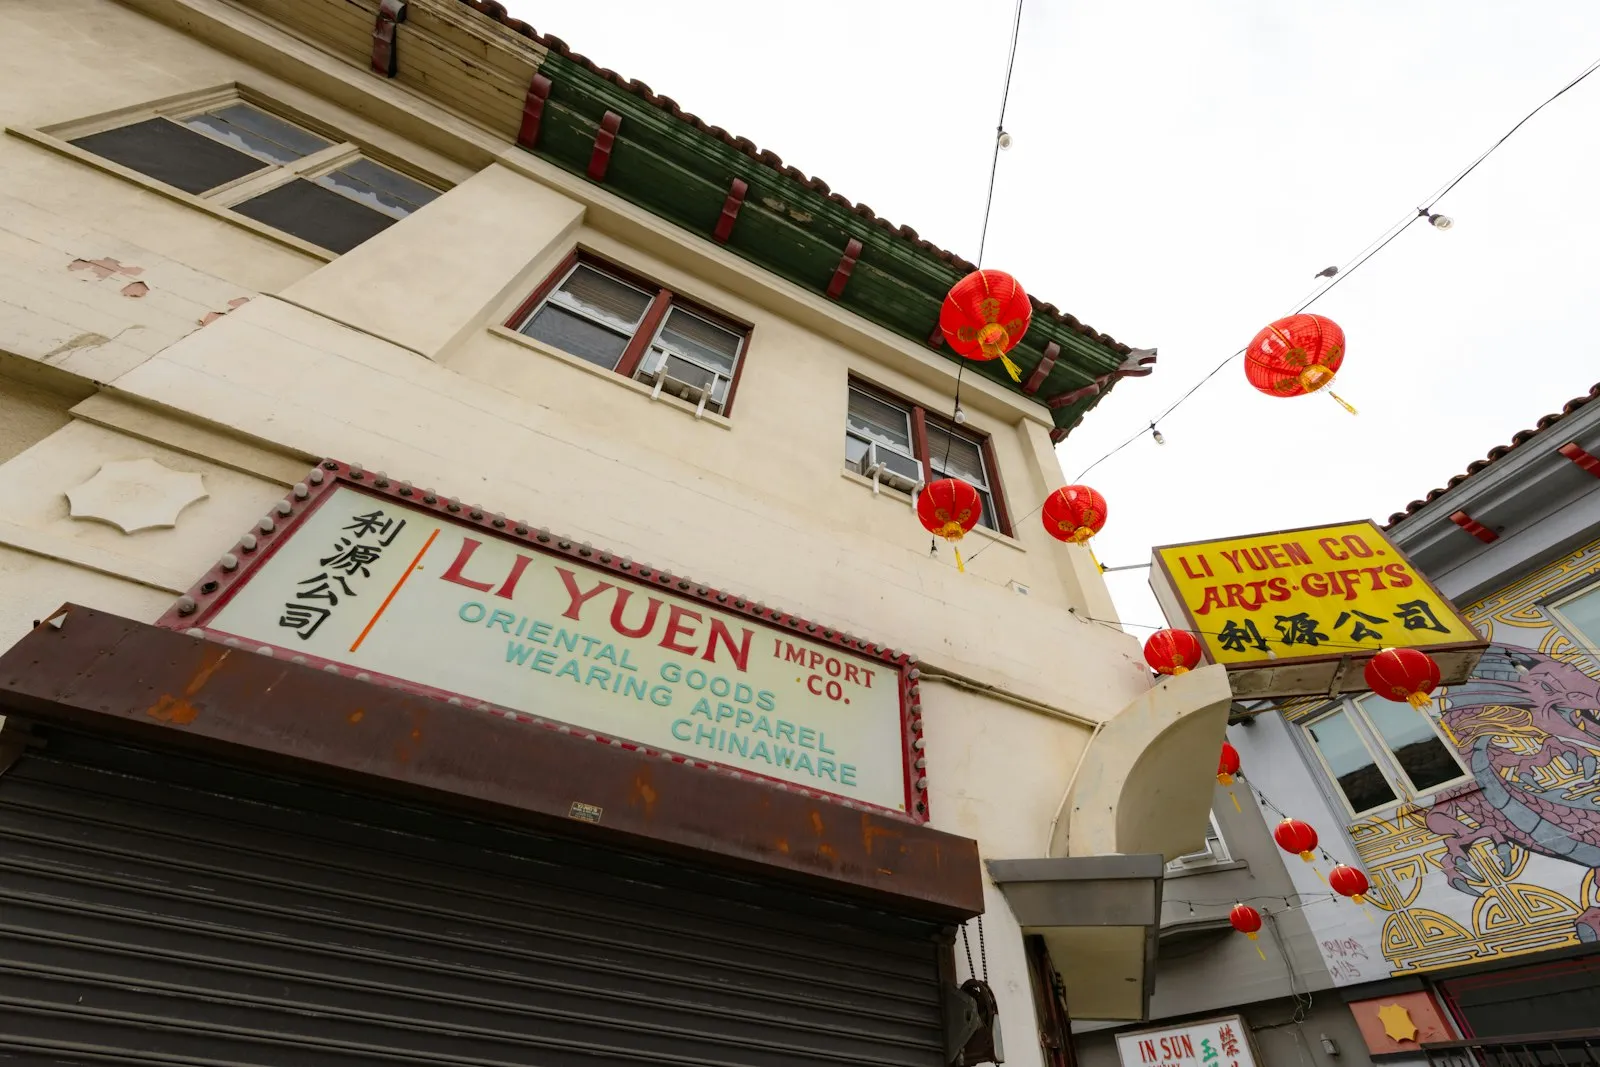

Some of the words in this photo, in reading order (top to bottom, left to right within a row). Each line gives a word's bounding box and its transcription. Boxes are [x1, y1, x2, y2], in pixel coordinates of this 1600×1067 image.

[278, 510, 407, 641] 利源公司
[1178, 555, 1214, 579] LI
[1220, 542, 1313, 573] YUEN
[1318, 534, 1386, 562] CO.
[440, 537, 533, 600] LI
[554, 565, 755, 673] YUEN
[1217, 599, 1451, 653] 利源公司
[458, 601, 639, 672] ORIENTAL
[660, 662, 777, 712] GOODS
[774, 639, 876, 689] IMPORT
[504, 641, 674, 707] WEARING
[690, 698, 836, 756] APPAREL
[807, 673, 851, 706] CO.
[671, 718, 858, 787] CHINAWARE
[1138, 1039, 1158, 1063] IN
[1159, 1034, 1196, 1061] SUN
